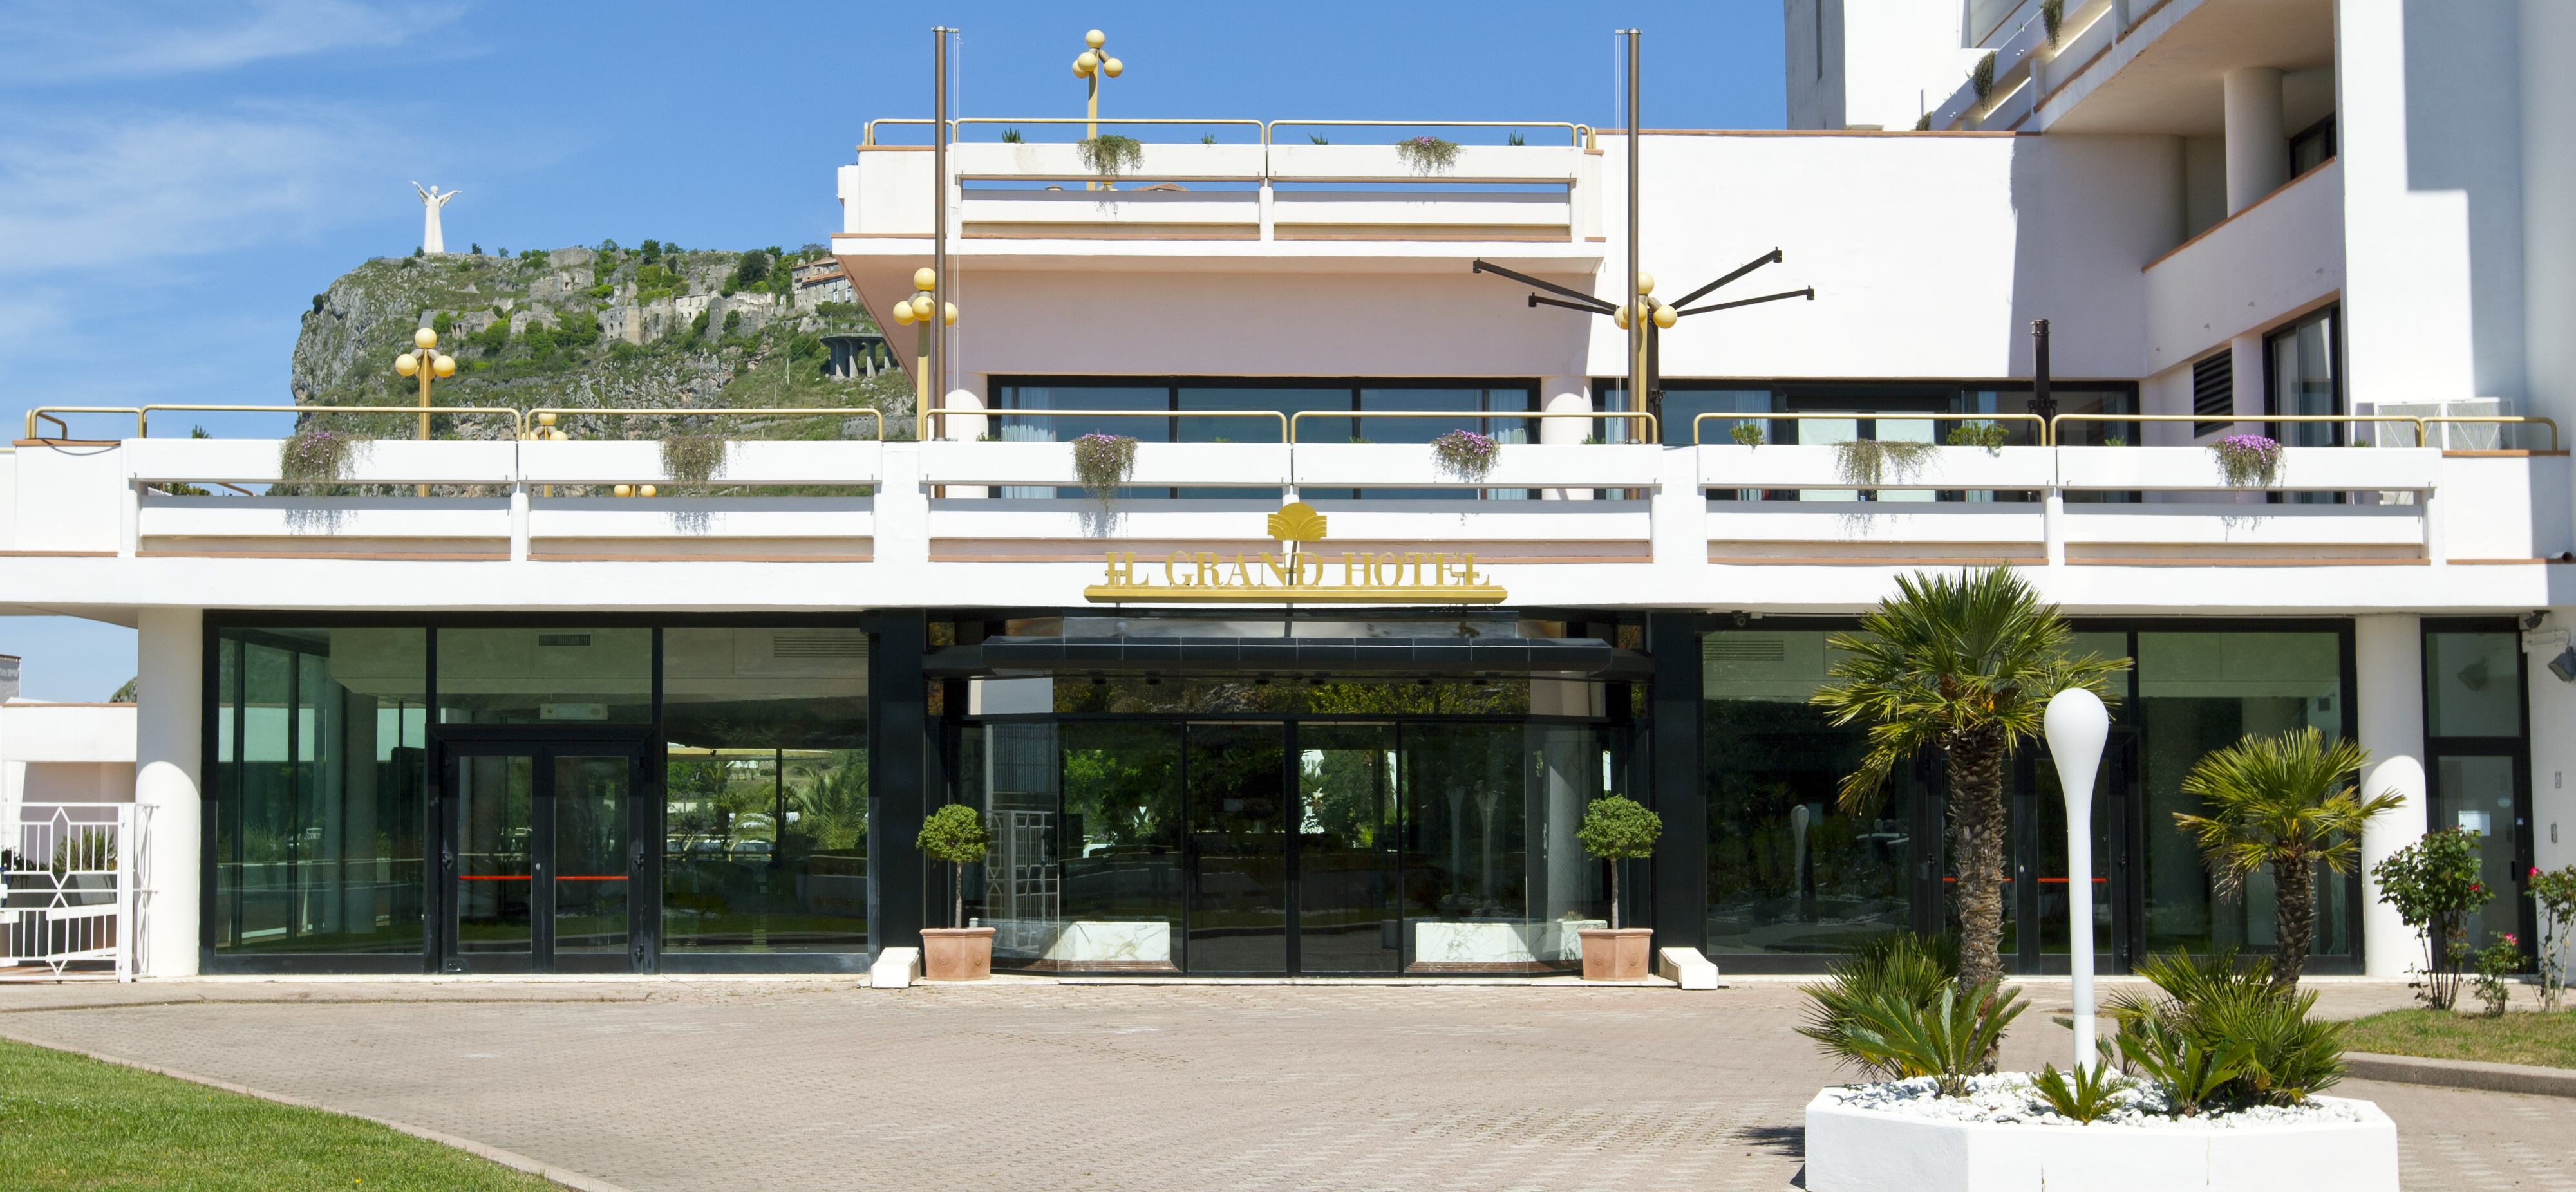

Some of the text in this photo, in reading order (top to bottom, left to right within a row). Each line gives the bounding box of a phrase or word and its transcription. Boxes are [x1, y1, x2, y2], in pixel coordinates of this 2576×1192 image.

[1104, 551, 1489, 586] IL GRAND HOTEL
